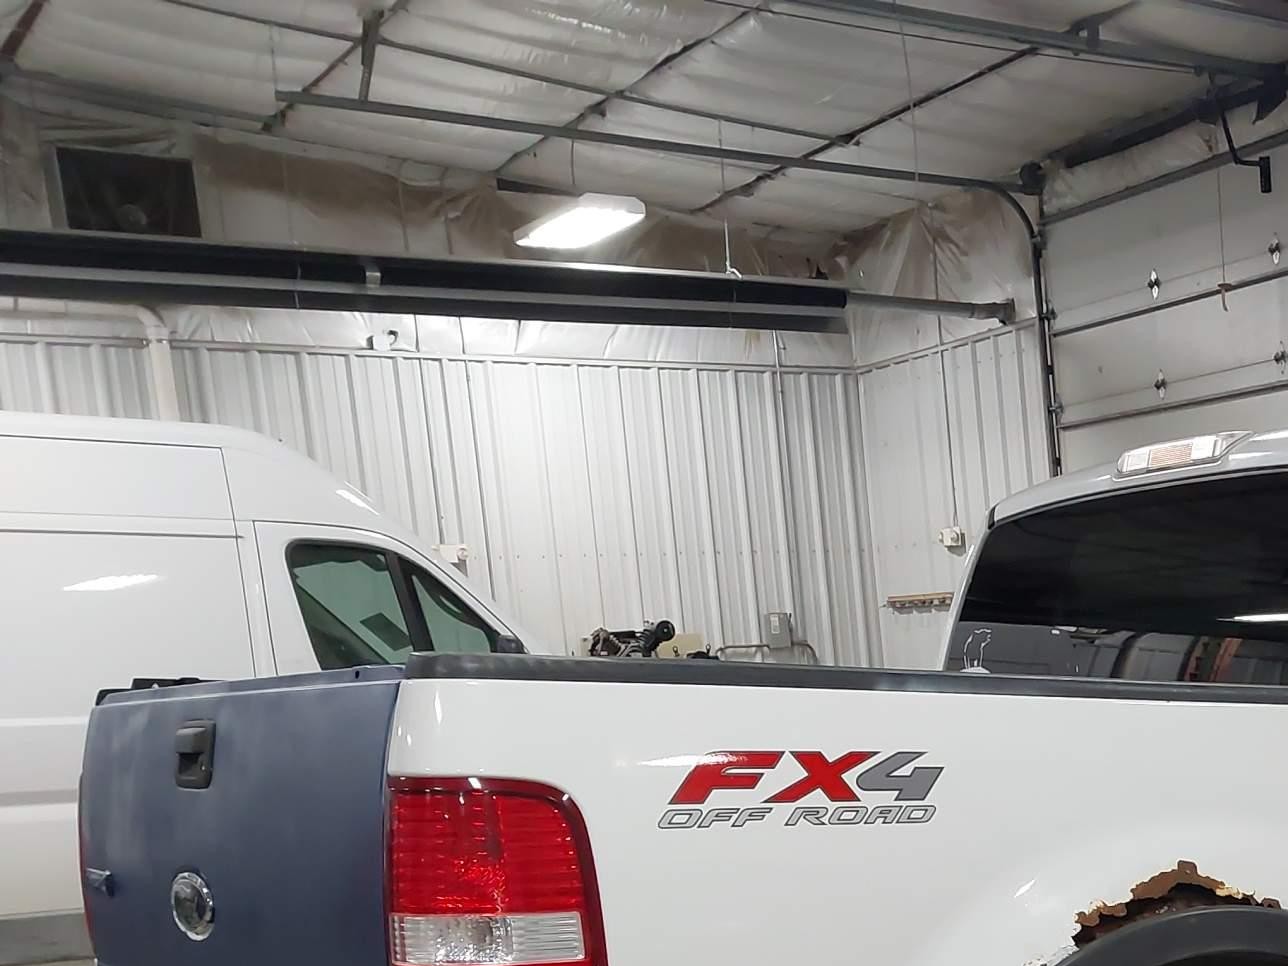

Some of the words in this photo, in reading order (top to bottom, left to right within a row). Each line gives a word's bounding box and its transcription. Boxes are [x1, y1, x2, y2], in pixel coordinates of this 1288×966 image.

[667, 750, 945, 805] FX4
[657, 806, 773, 829] OFF
[783, 804, 937, 826] ROAD
